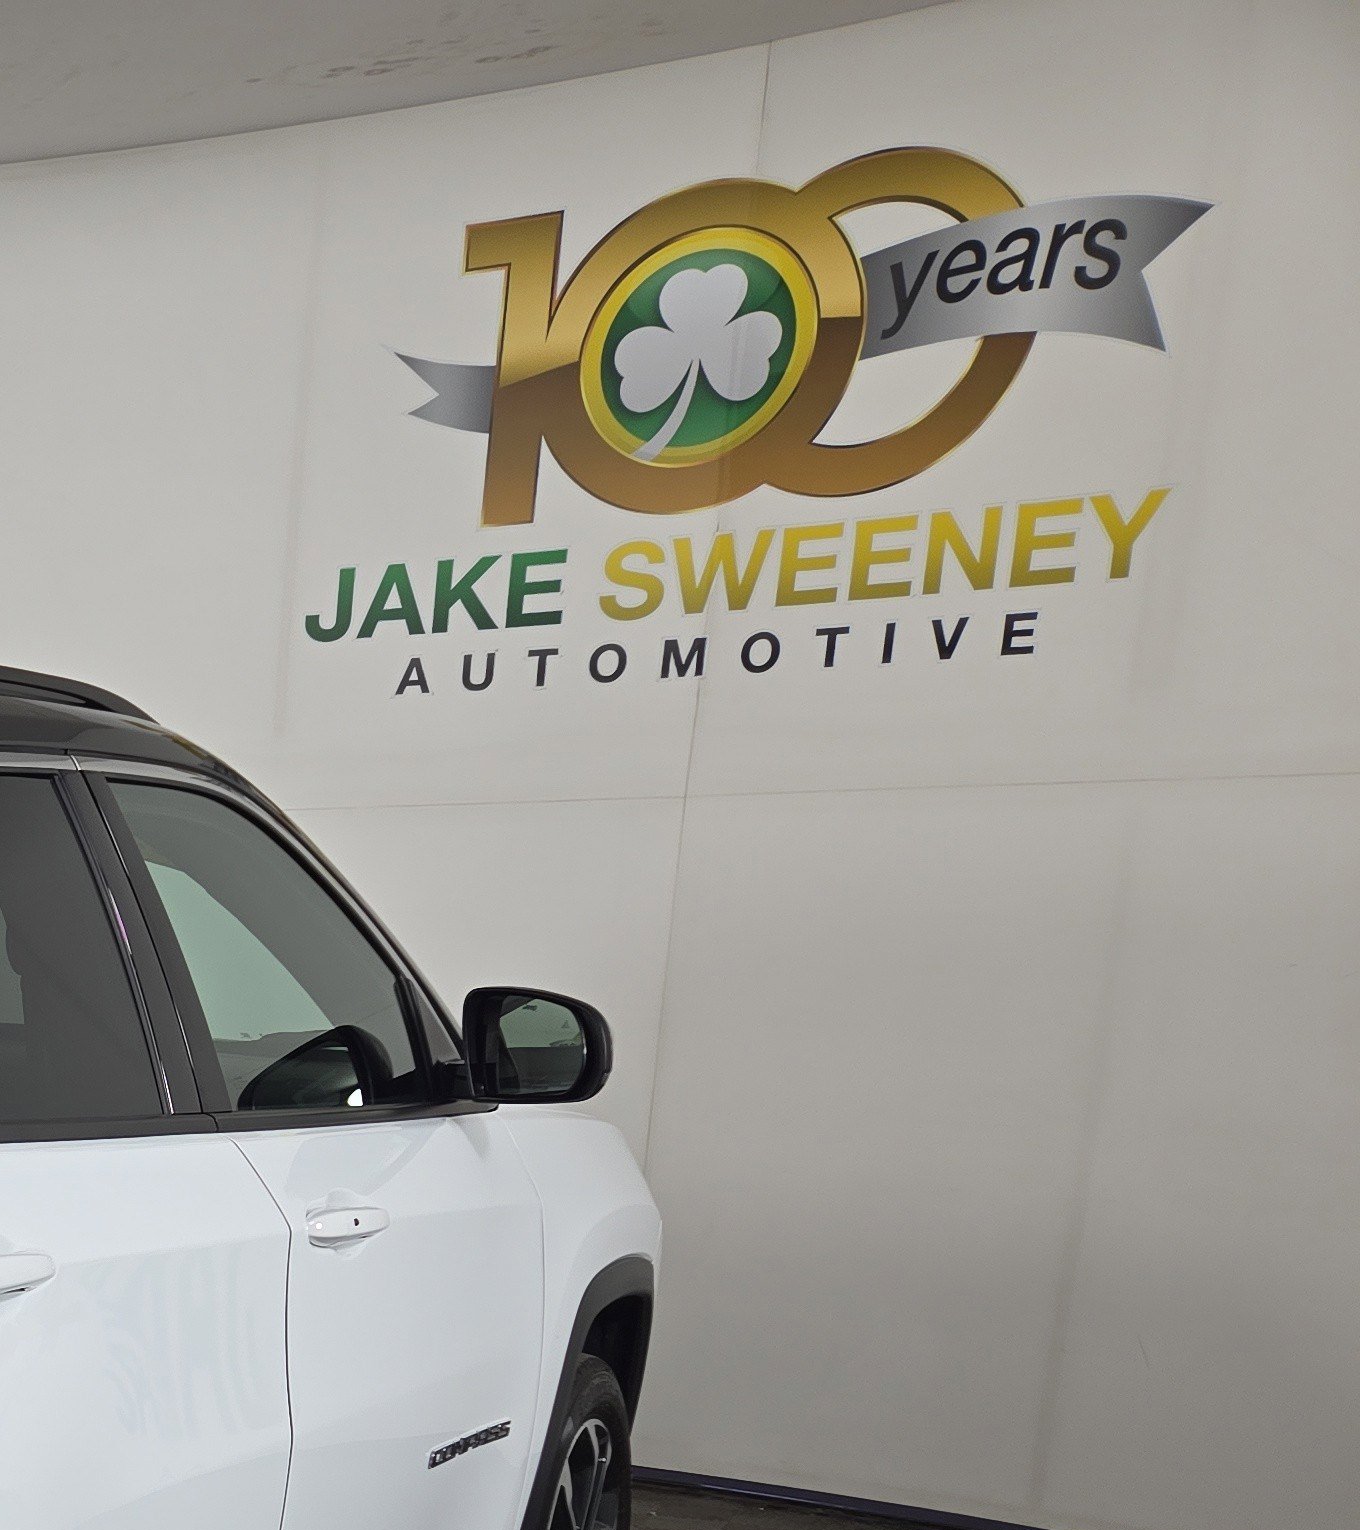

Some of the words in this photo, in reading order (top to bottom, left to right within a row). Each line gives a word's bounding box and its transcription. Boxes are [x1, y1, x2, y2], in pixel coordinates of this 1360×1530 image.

[463, 146, 1040, 529] 100
[881, 214, 1129, 339] years
[303, 547, 569, 643] JAKE
[598, 487, 1173, 622] SWEENEY
[394, 611, 1040, 698] AUTOMOTIVE
